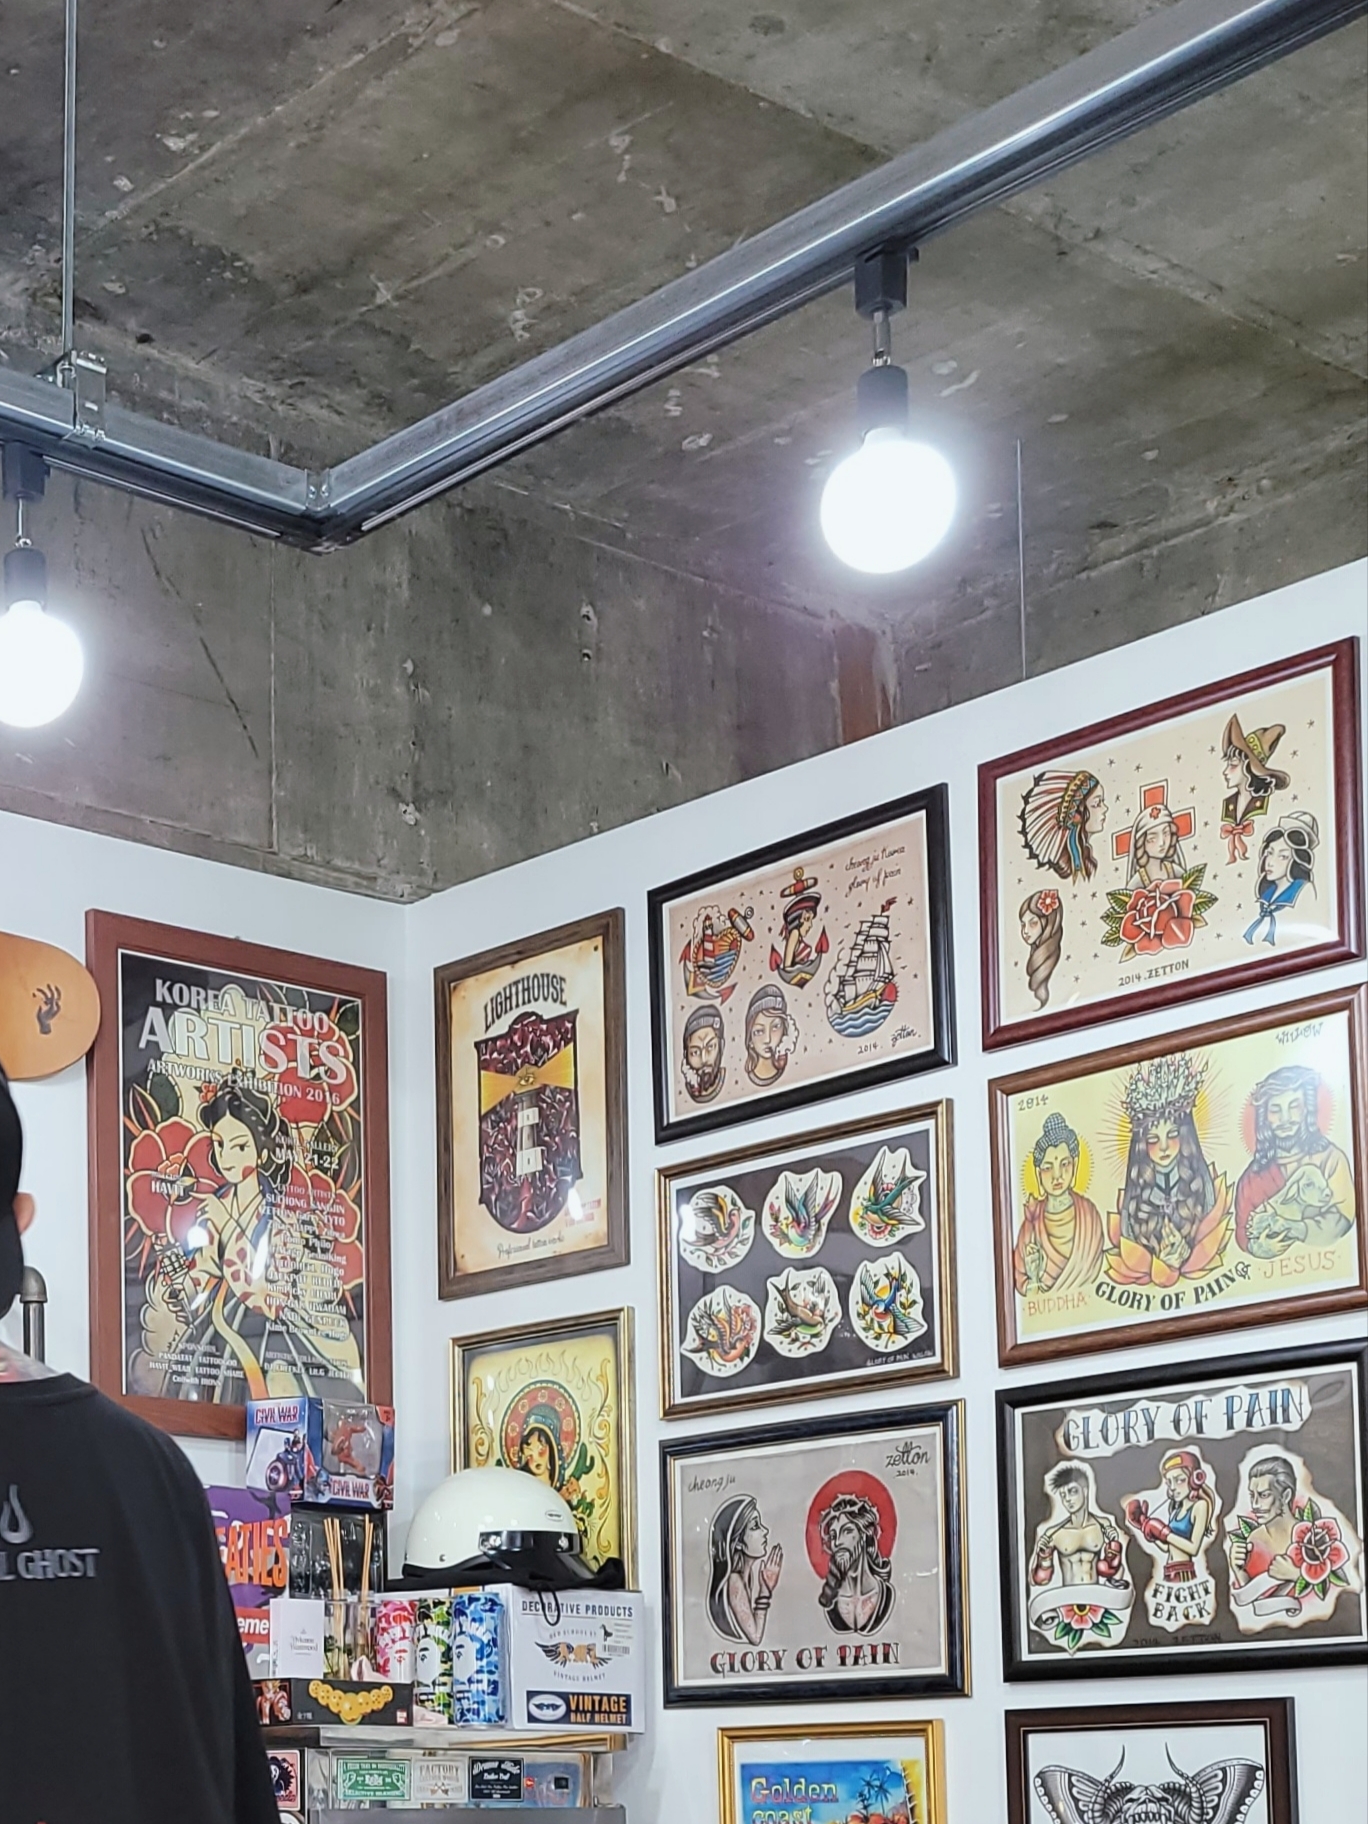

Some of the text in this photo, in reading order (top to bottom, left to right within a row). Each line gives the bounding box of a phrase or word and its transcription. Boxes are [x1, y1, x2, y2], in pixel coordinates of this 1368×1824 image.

[156, 979, 329, 1033] KOREA TATTOO
[483, 973, 567, 1033] LIGHTHOUSE
[139, 1006, 347, 1084] ARTISTS
[147, 1058, 340, 1104] ARTWORKS EXHIBITION 2016
[276, 1148, 339, 1169] MAY 21-22
[152, 1180, 184, 1196] HAVIT
[1095, 1271, 1236, 1312] GLORY OF PAIN
[255, 1405, 299, 1424] CIVIL WAR
[1063, 1387, 1306, 1452] GLORY OF PAIN
[332, 1480, 370, 1499] CIVIL WAR
[17, 1548, 101, 1579] GHOST
[1152, 1580, 1213, 1602] FIGHT
[585, 1602, 633, 1618] PRODUCTS
[1153, 1600, 1212, 1622] BACK
[710, 1643, 900, 1678] GLORY OF PAIN
[569, 1694, 627, 1712] VINTAGE
[570, 1713, 627, 1724] HALF HELMET
[750, 1776, 839, 1804] Golden
